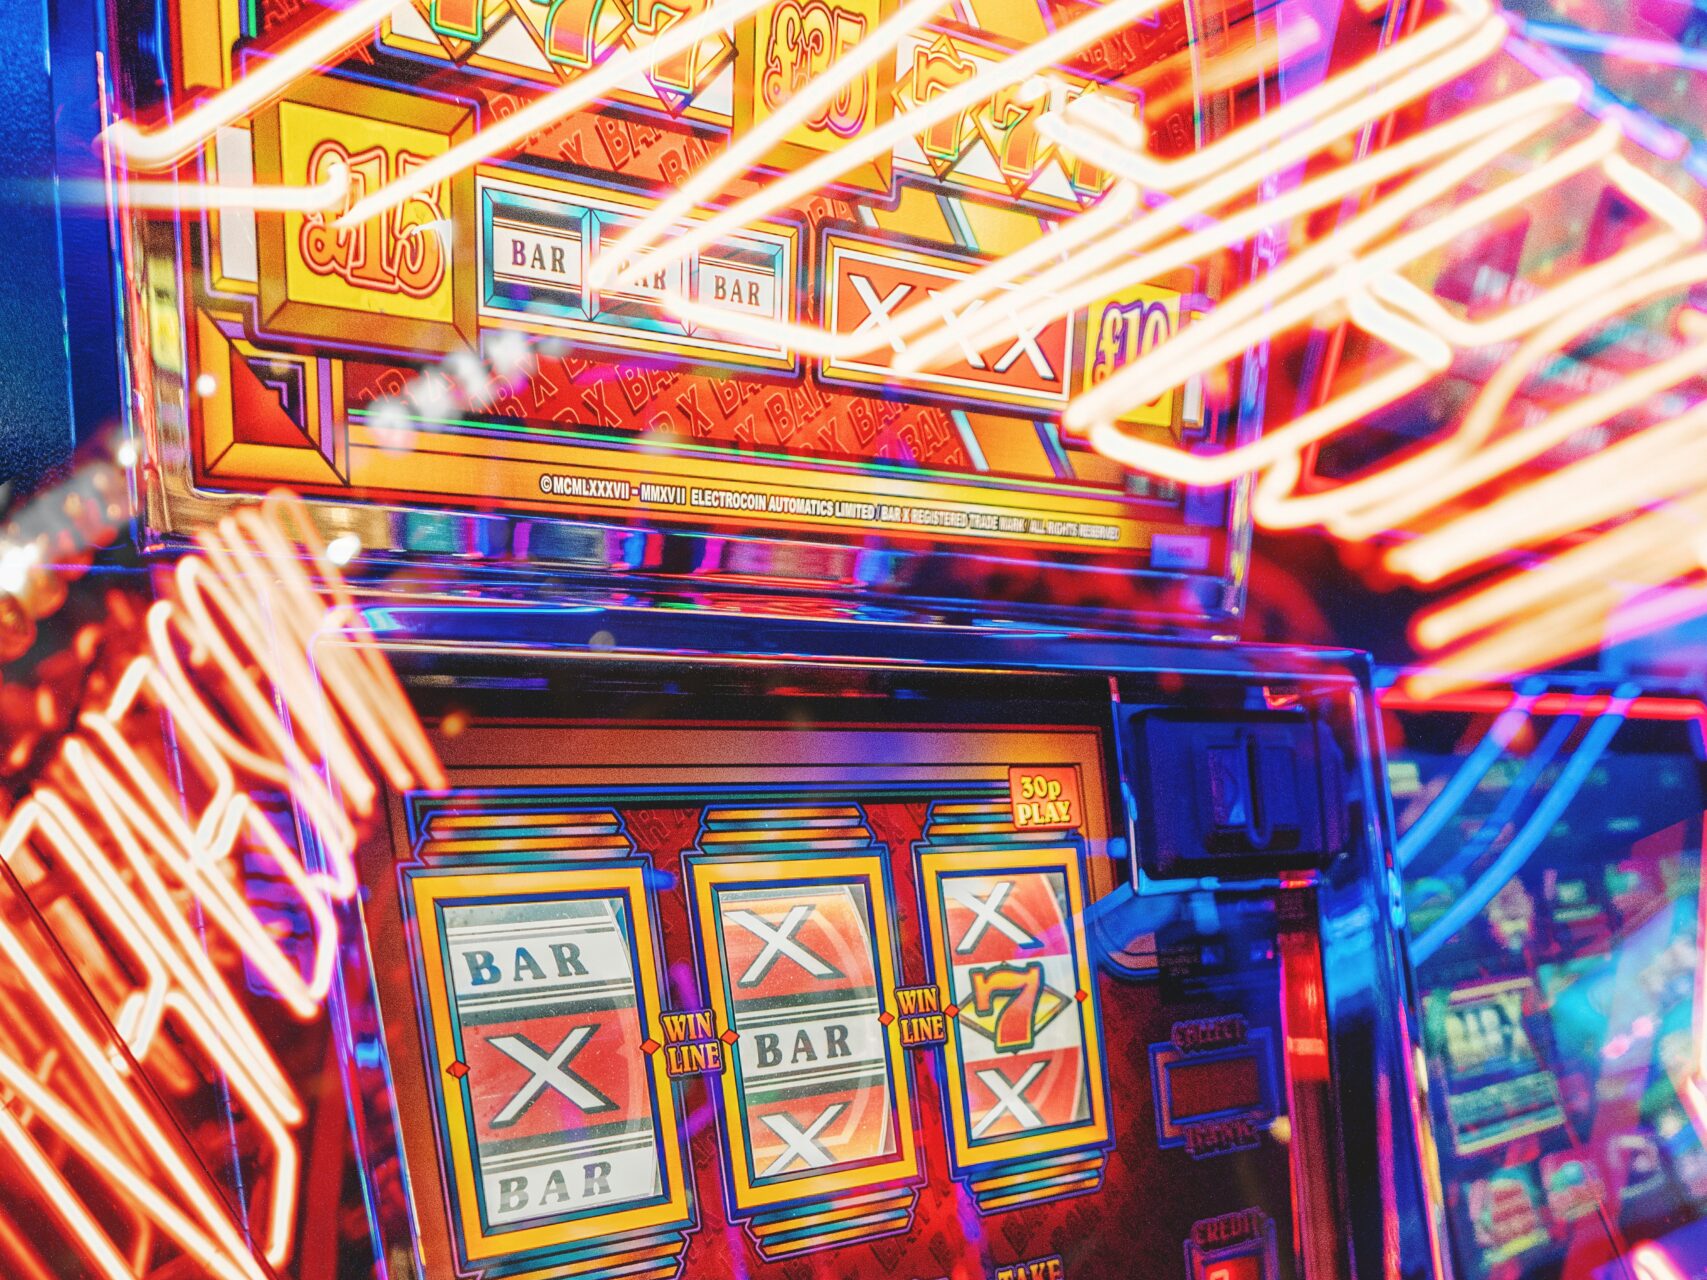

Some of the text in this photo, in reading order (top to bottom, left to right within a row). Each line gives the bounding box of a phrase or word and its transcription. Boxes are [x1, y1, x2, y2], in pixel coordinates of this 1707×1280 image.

[301, 140, 448, 298] £15
[511, 238, 567, 274] BAR
[714, 274, 760, 307] BAR
[639, 483, 687, 506] MMXVII
[690, 490, 767, 511] ELECTROCOIN
[768, 496, 834, 517] AUTOMATICS
[836, 501, 875, 521] LIMITED
[880, 505, 901, 522] BAR
[901, 507, 911, 523] X
[911, 508, 968, 528] REGISTERED
[968, 514, 998, 530] TRADE
[1021, 776, 1061, 800] 30p
[1017, 801, 1071, 826] PLAY
[953, 880, 1045, 954] X
[462, 942, 589, 986] BAR
[723, 903, 848, 988] X
[897, 987, 938, 1016] WIN
[969, 961, 1045, 1052] 7
[661, 1012, 713, 1042] WIN
[754, 1023, 852, 1069] BAR
[899, 1014, 945, 1045] LINE
[485, 1023, 621, 1129] X
[668, 1041, 721, 1075] LINE
[971, 1059, 1051, 1139] X
[758, 1101, 850, 1178] X
[498, 1161, 613, 1214] BAR
